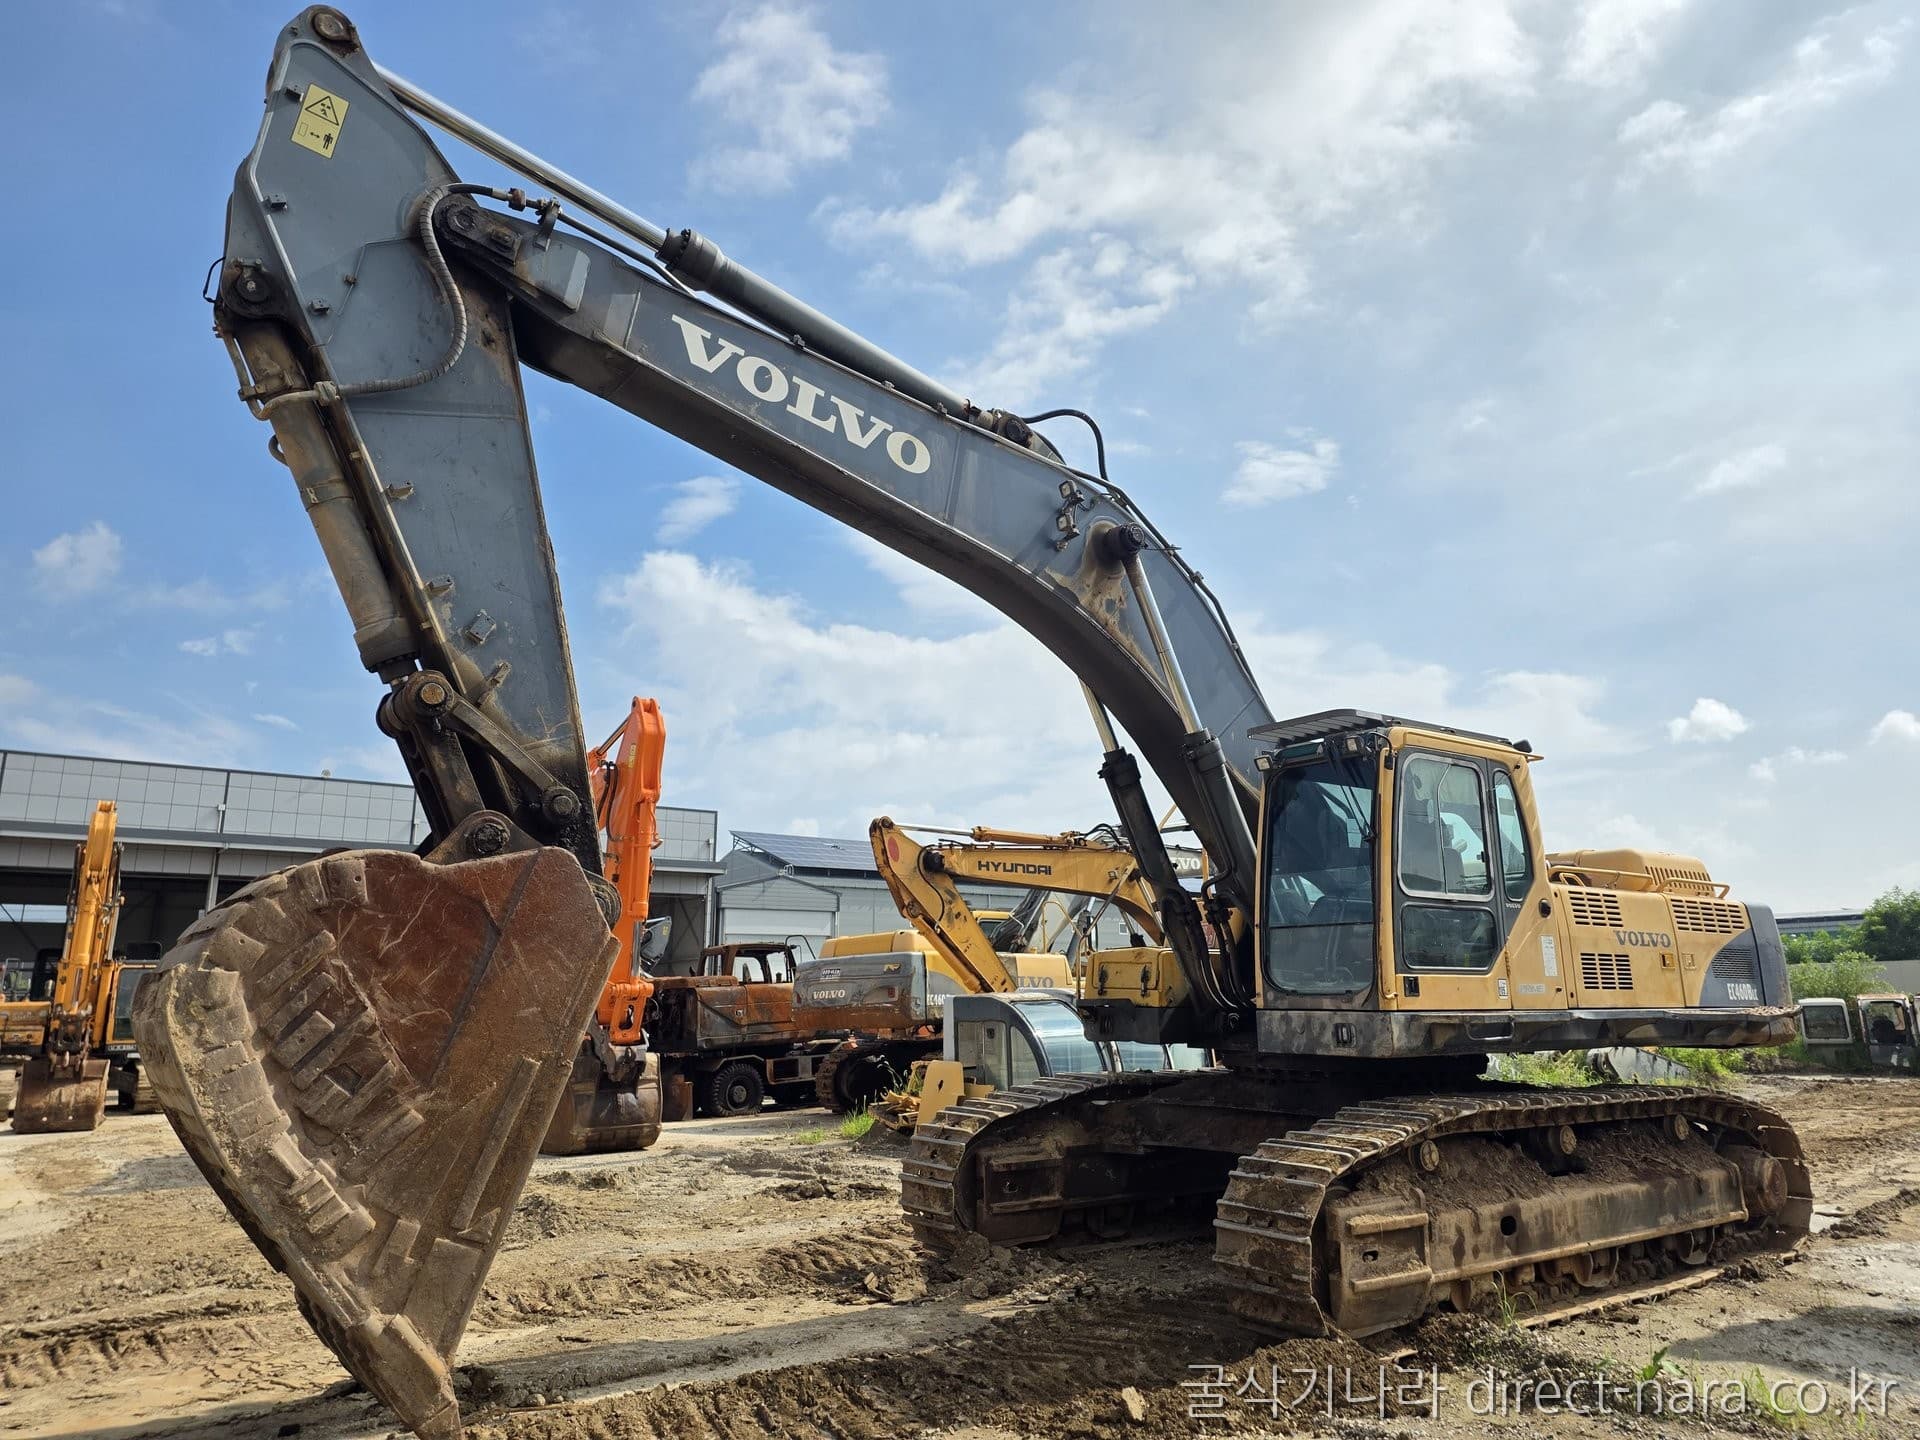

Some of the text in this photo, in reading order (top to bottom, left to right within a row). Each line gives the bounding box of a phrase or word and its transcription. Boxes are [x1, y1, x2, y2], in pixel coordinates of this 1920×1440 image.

[671, 314, 931, 474] VOLVO
[977, 860, 1052, 875] HYUNDAI
[1613, 930, 1671, 947] VOLVO
[1017, 976, 1054, 988] LVO
[813, 989, 846, 999] VOLVO
